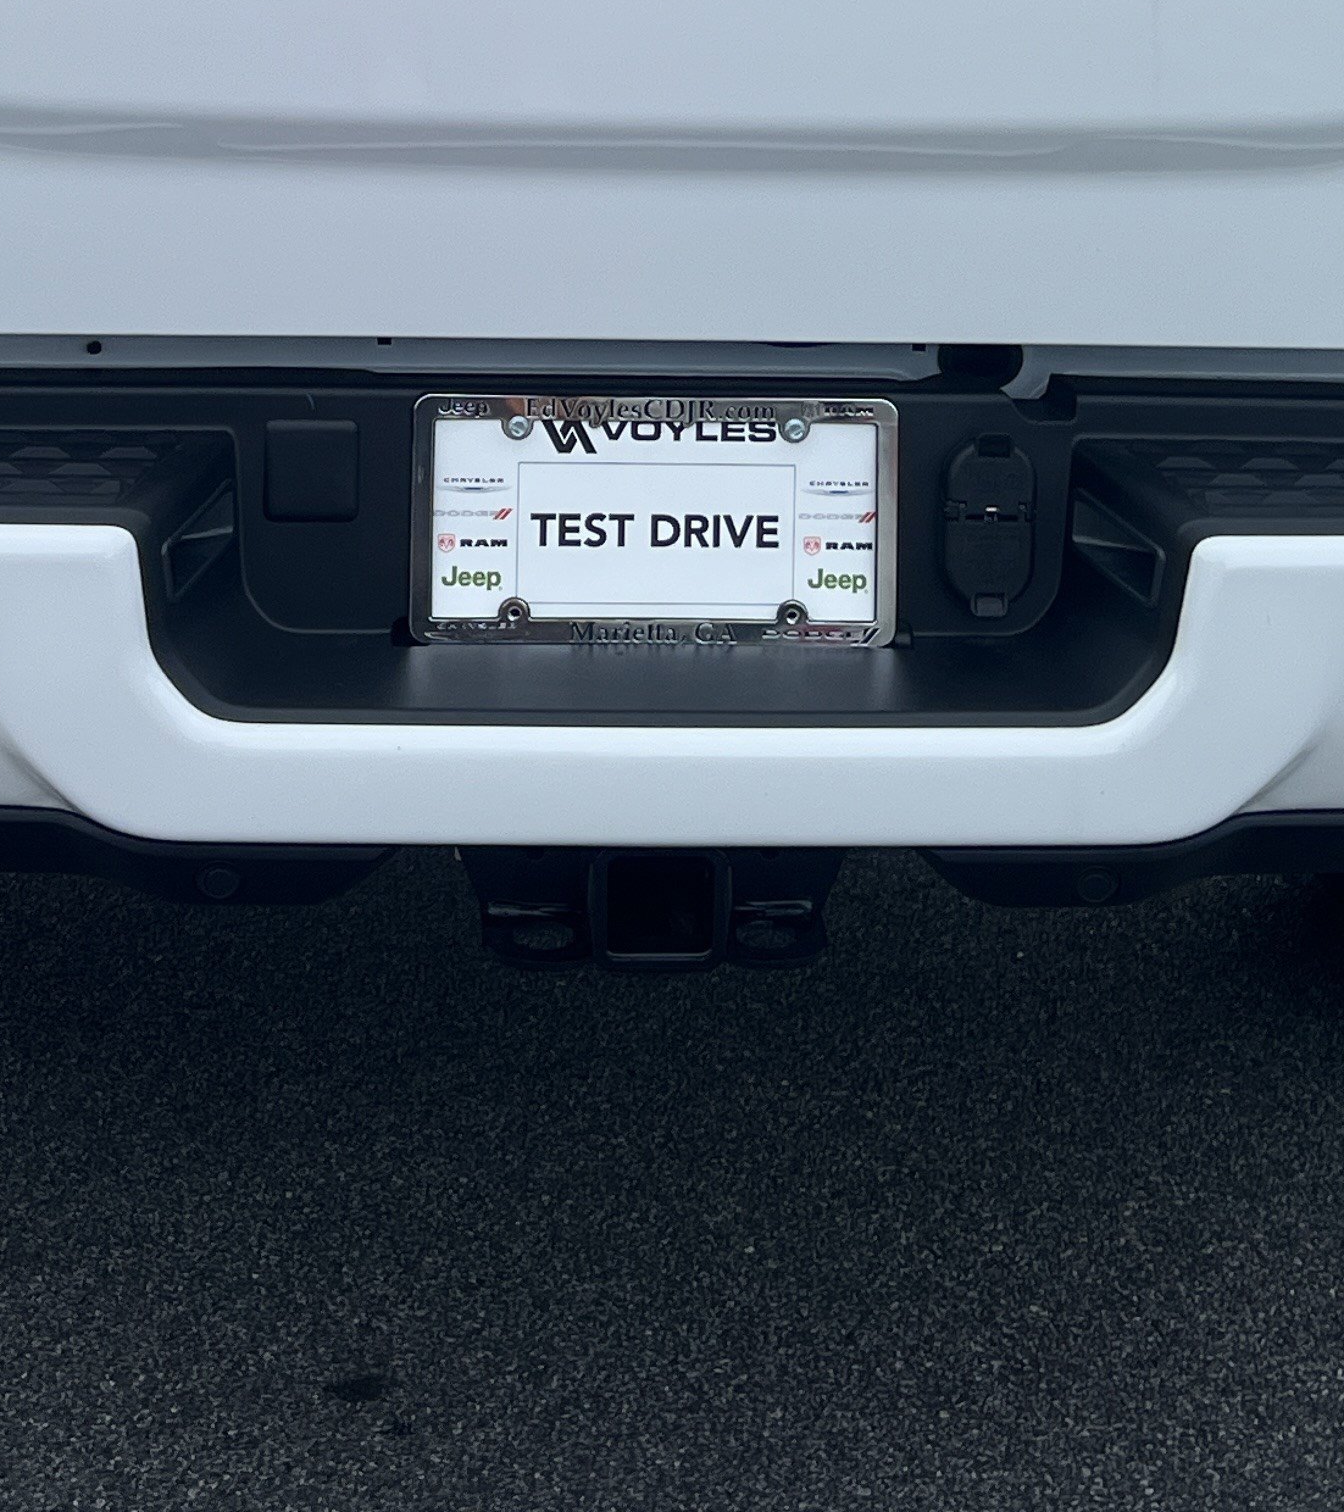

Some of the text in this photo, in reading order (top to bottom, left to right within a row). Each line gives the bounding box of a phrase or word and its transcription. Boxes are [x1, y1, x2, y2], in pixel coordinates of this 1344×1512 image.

[523, 397, 777, 428] EdVoylesCDJR.com
[601, 420, 777, 443] VOYLES
[459, 538, 508, 547] RAM
[531, 512, 780, 549] TEST DRIVE
[825, 541, 874, 551] RAM
[441, 565, 501, 591] Jeep
[807, 568, 867, 594] Jeep
[694, 621, 738, 645] GA
